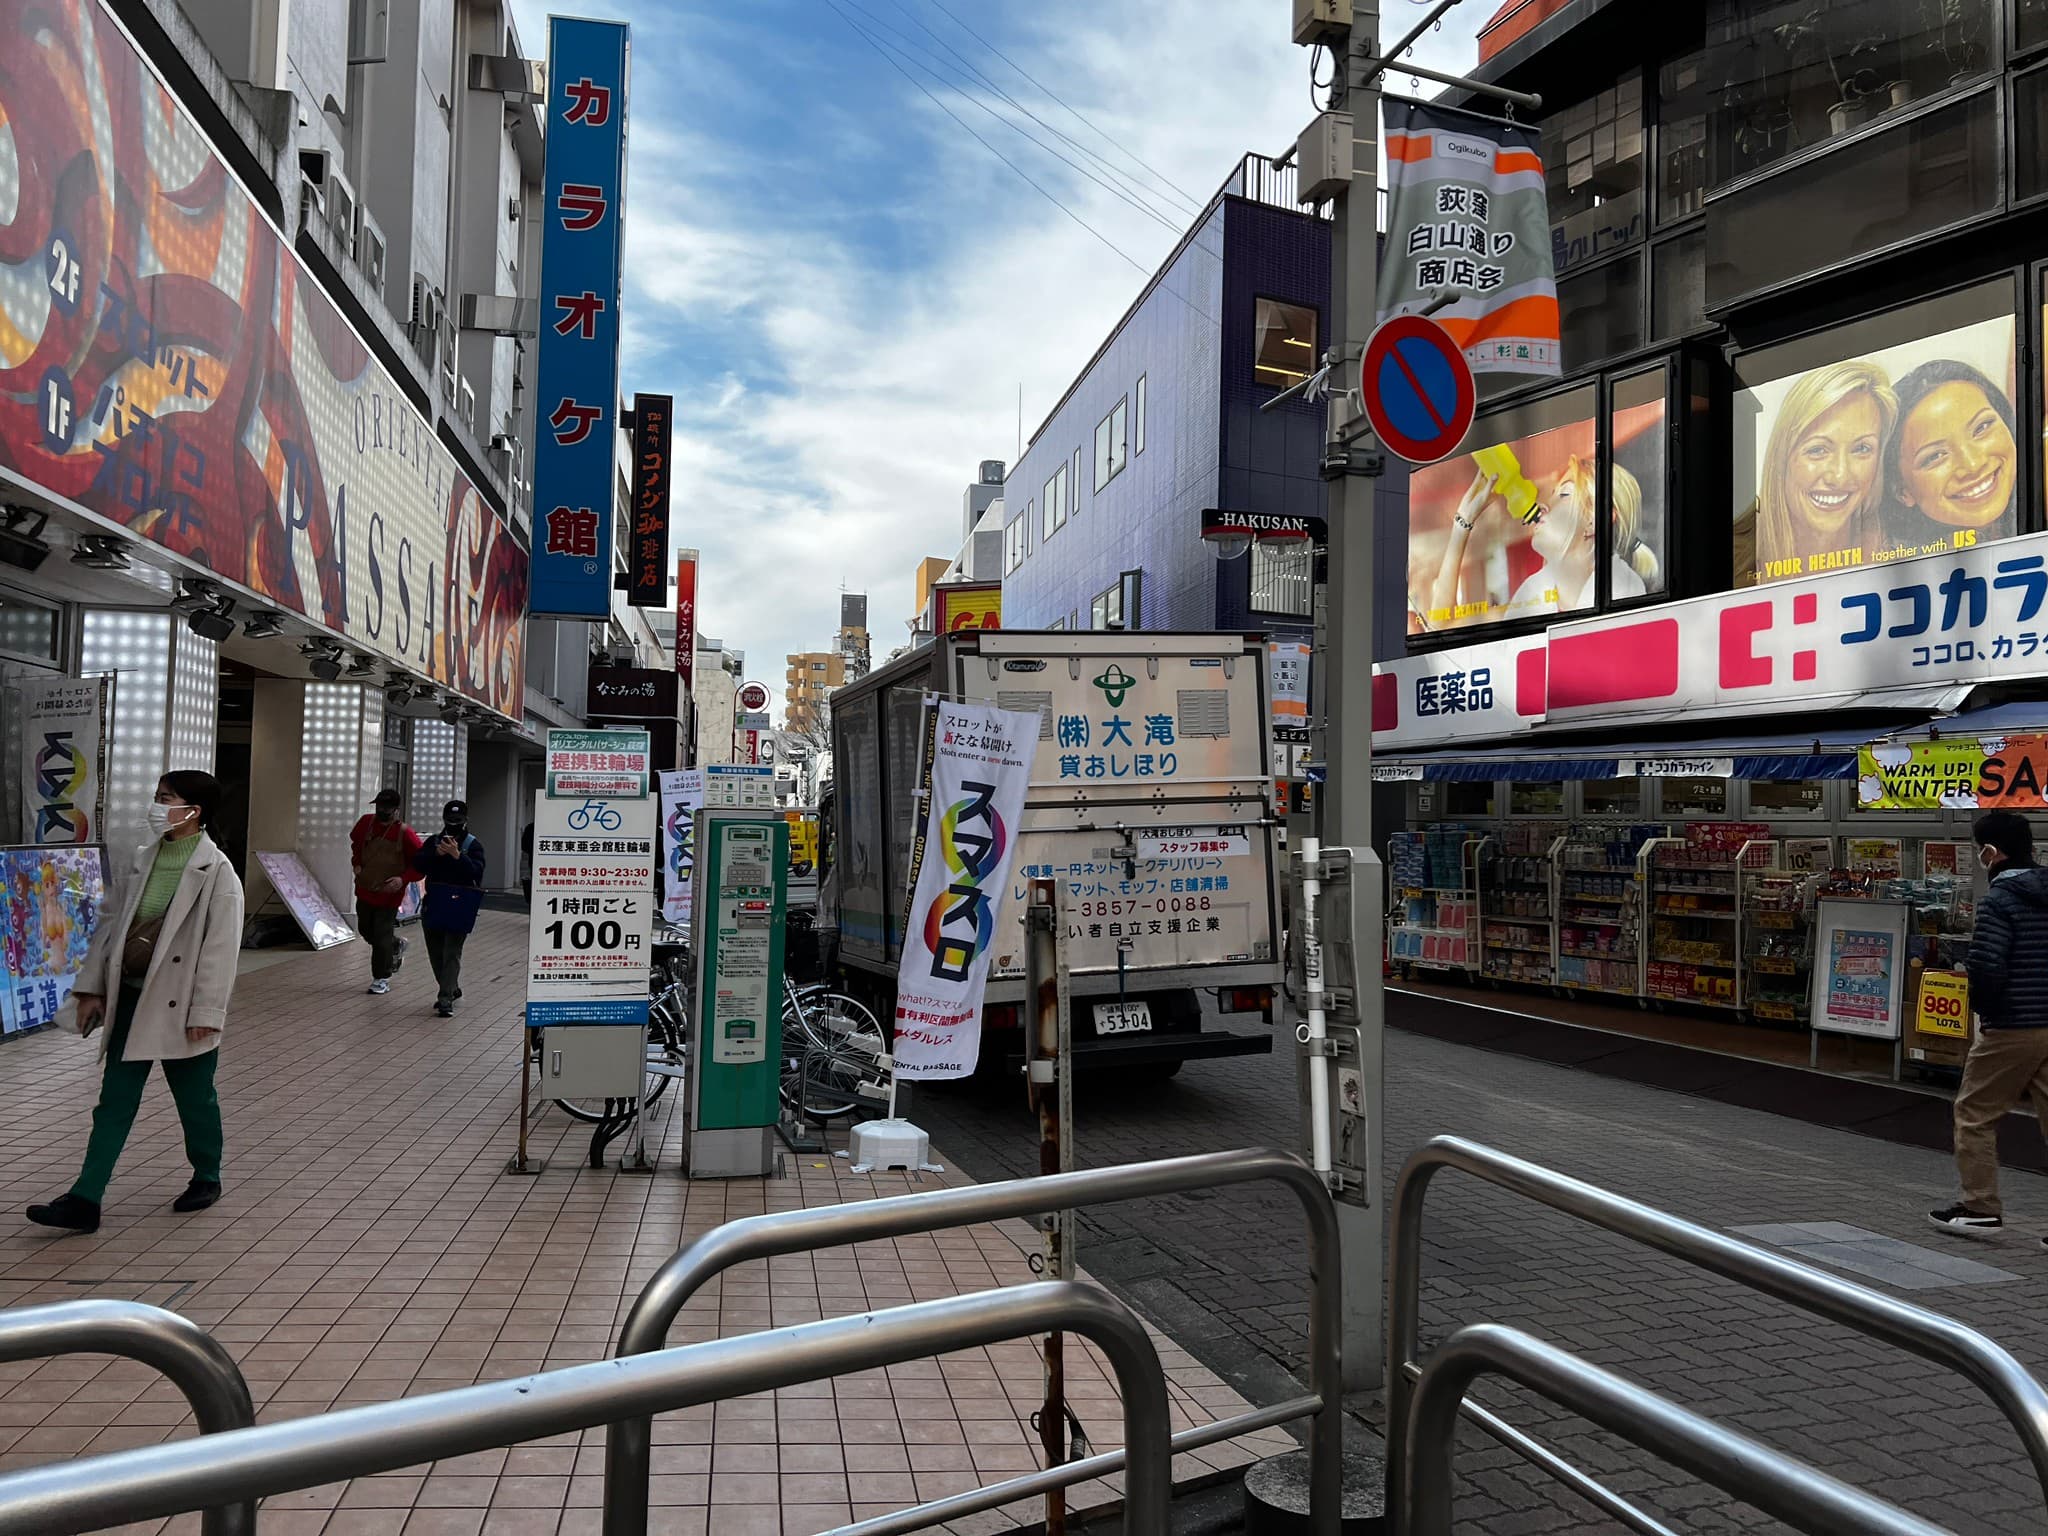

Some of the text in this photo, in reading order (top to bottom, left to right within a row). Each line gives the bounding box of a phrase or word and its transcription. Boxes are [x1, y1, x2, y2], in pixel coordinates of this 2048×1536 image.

[1448, 142, 1487, 158] Ogikubo
[1438, 187, 1489, 222] 荻窪
[1407, 222, 1515, 256] 白山通り
[51, 239, 80, 304] 2F
[1417, 260, 1504, 290] 商店会
[545, 77, 612, 558] カラオケ館
[100, 280, 209, 399] スロット
[48, 380, 71, 440] 1F
[355, 393, 451, 533] ORIENTAL
[637, 452, 664, 587] コメダ珈琲店
[279, 438, 479, 686] PASSAGE
[1747, 529, 1977, 582] For YOUR HEALTH together with US
[1841, 555, 2048, 645] ココカラ
[676, 600, 693, 667] なごみの湯
[597, 682, 656, 697] なごみの湯
[1416, 669, 1493, 717] 医薬品
[945, 715, 1003, 733] スロットが
[551, 753, 645, 771] 提携駐輪場
[940, 747, 957, 757] Slots
[957, 752, 980, 760] enter
[1001, 757, 1024, 767] dawn.
[1058, 753, 1178, 778] 貸おしぼり
[1654, 762, 1714, 774] ココカラファイン
[1884, 763, 1973, 778] WARM UP!
[1882, 779, 1973, 799] WINTER
[1977, 755, 2048, 799] SA
[538, 840, 650, 853] 荻窪東亜会館駐輪場
[1141, 828, 1193, 838] 大滝おしぼり
[1159, 841, 1229, 853] スタッフ募集中
[539, 867, 576, 876] 営業時間
[930, 780, 997, 982] スマスロ
[547, 898, 637, 915] 1時間ごと
[1924, 995, 1961, 1017] 980
